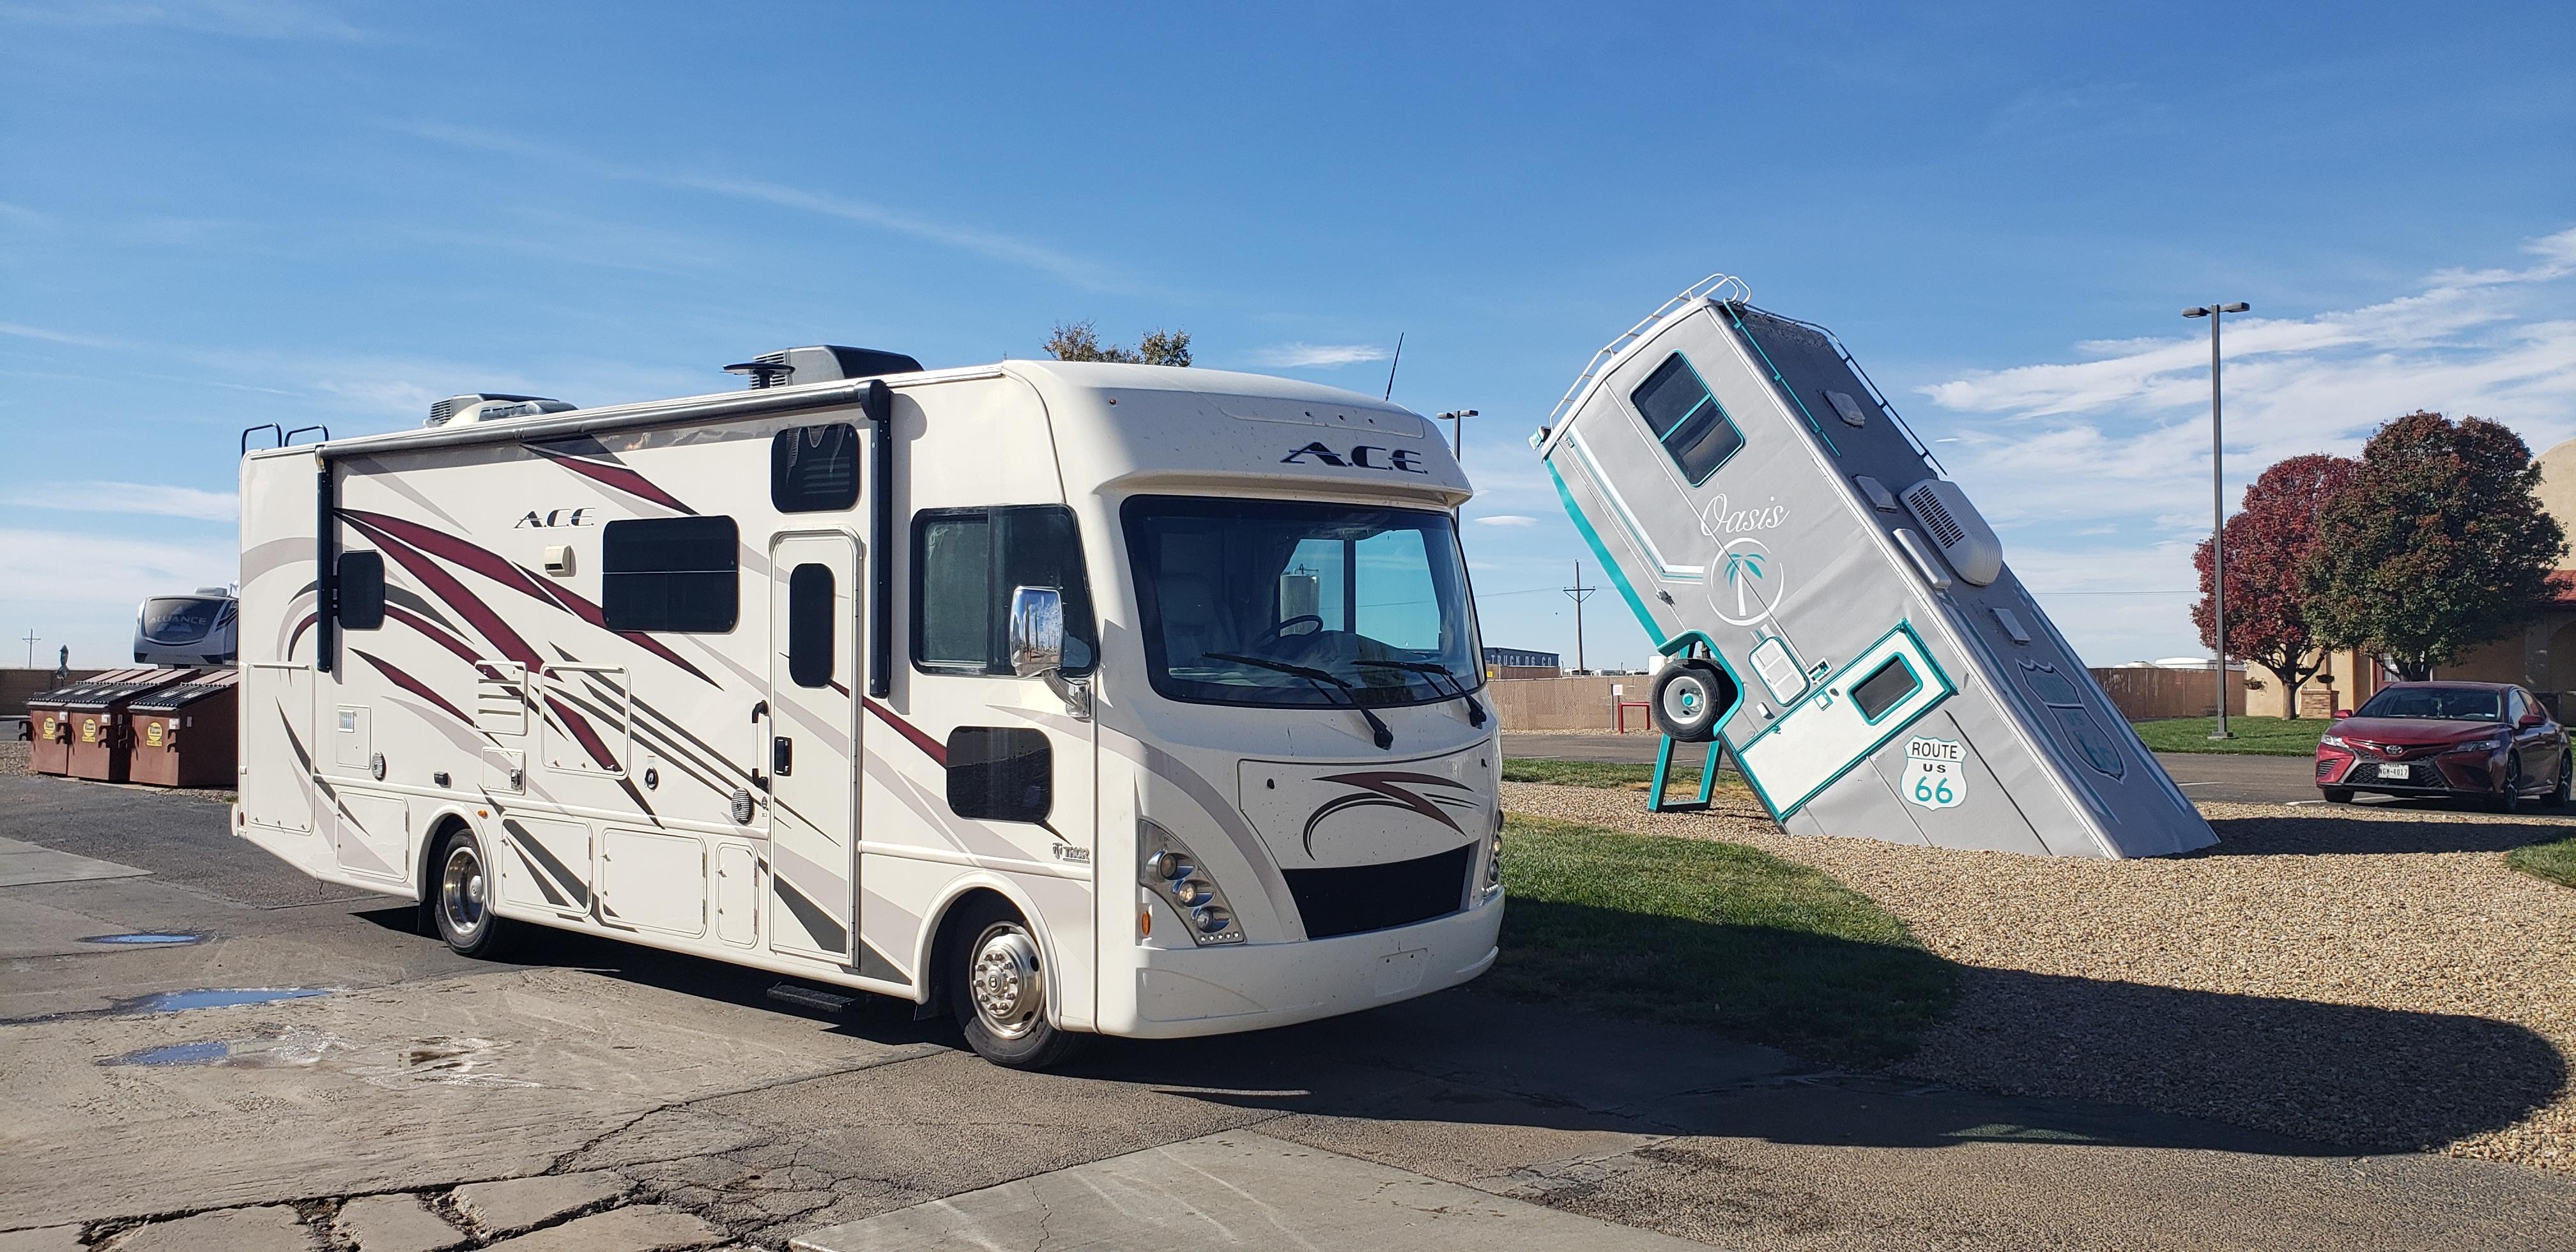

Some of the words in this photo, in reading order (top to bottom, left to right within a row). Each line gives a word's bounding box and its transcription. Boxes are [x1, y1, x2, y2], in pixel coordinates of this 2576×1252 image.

[1700, 493, 1790, 536] Oasis
[149, 613, 206, 625] ALLIANCE
[1912, 742, 1958, 760] ROUTE
[1922, 763, 1947, 773] US
[1915, 775, 1953, 804] 66
[1063, 846, 1090, 859] THOR
